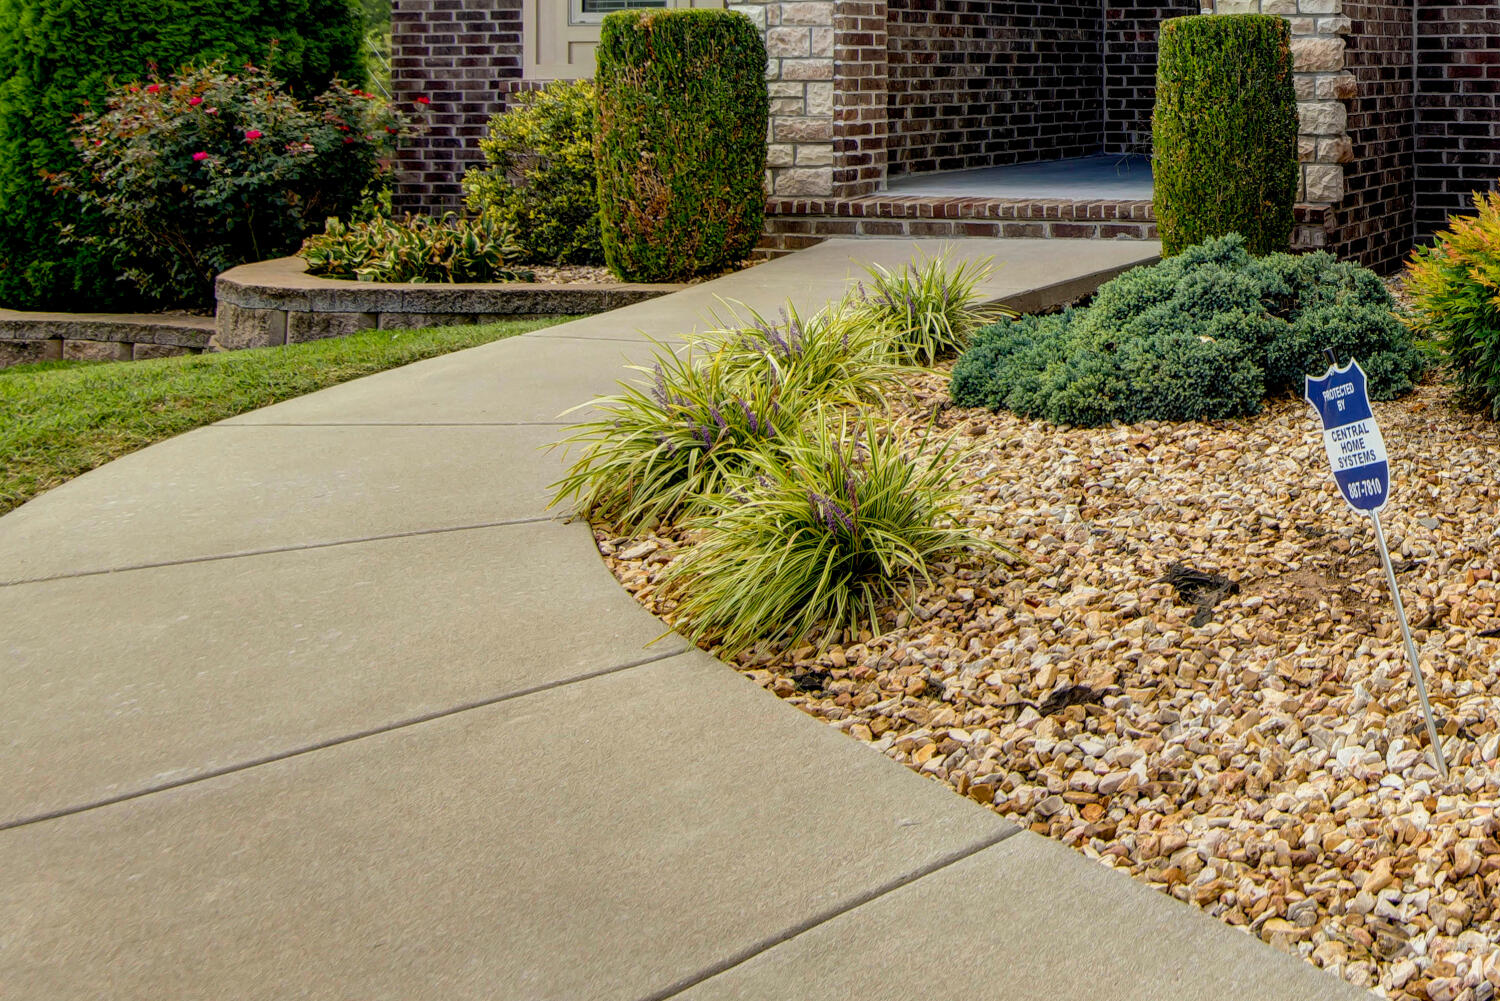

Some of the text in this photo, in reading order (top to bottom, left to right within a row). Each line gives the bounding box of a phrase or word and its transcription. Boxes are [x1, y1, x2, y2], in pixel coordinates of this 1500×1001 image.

[1322, 382, 1355, 401] PROTECTED
[1336, 398, 1346, 412] BY
[1331, 422, 1370, 442] CENTRAL
[1340, 438, 1366, 453] HOME
[1337, 449, 1377, 469] SYSTEMS
